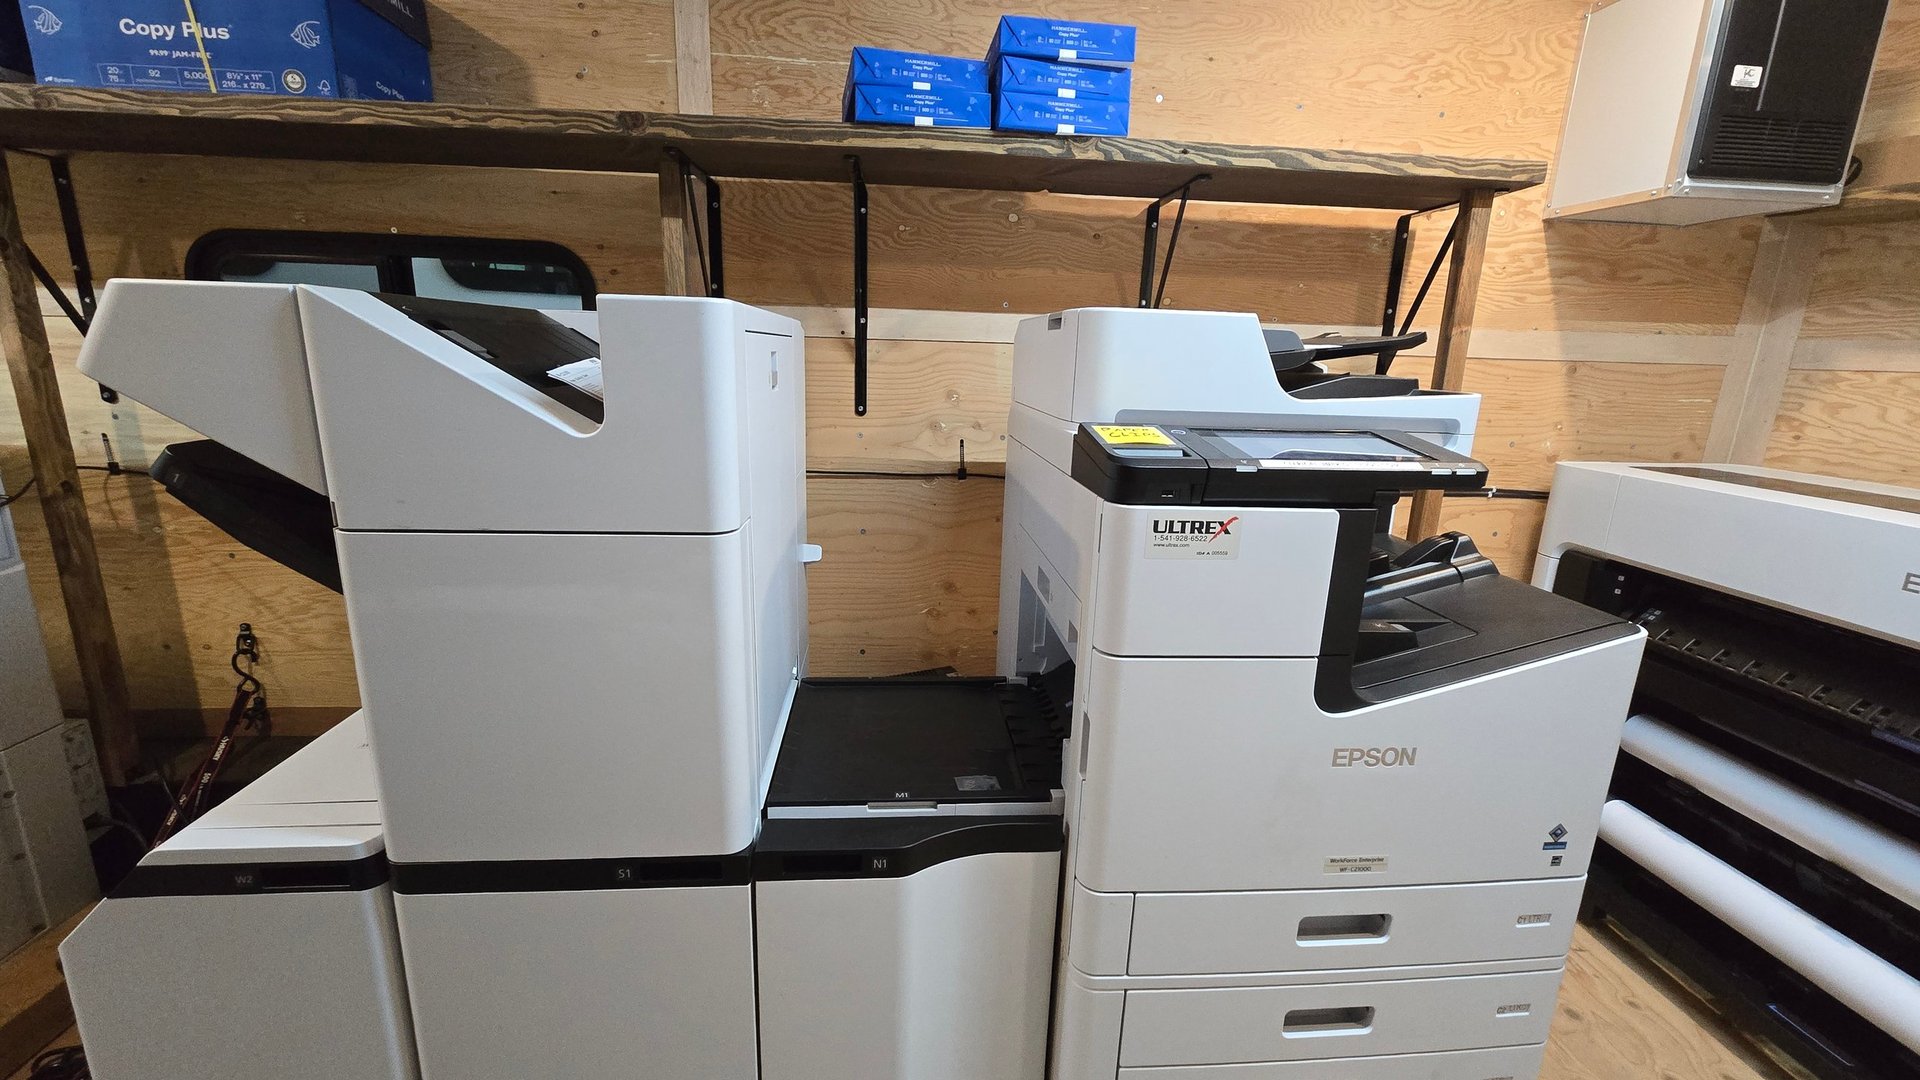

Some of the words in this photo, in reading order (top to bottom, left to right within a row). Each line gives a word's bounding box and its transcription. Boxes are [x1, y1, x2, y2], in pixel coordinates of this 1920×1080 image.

[119, 18, 175, 41] Copy
[181, 21, 230, 40] Plus
[172, 50, 212, 59] JAM-FRE
[107, 66, 119, 74] 20
[148, 69, 160, 77] 92
[1153, 517, 1237, 536] ULTREX
[1331, 747, 1417, 767] EPSON
[873, 859, 887, 868] N1
[1330, 856, 1358, 864] WorkForce
[1359, 855, 1384, 864] Enterprise
[618, 869, 630, 879] S1
[235, 875, 252, 883] W2
